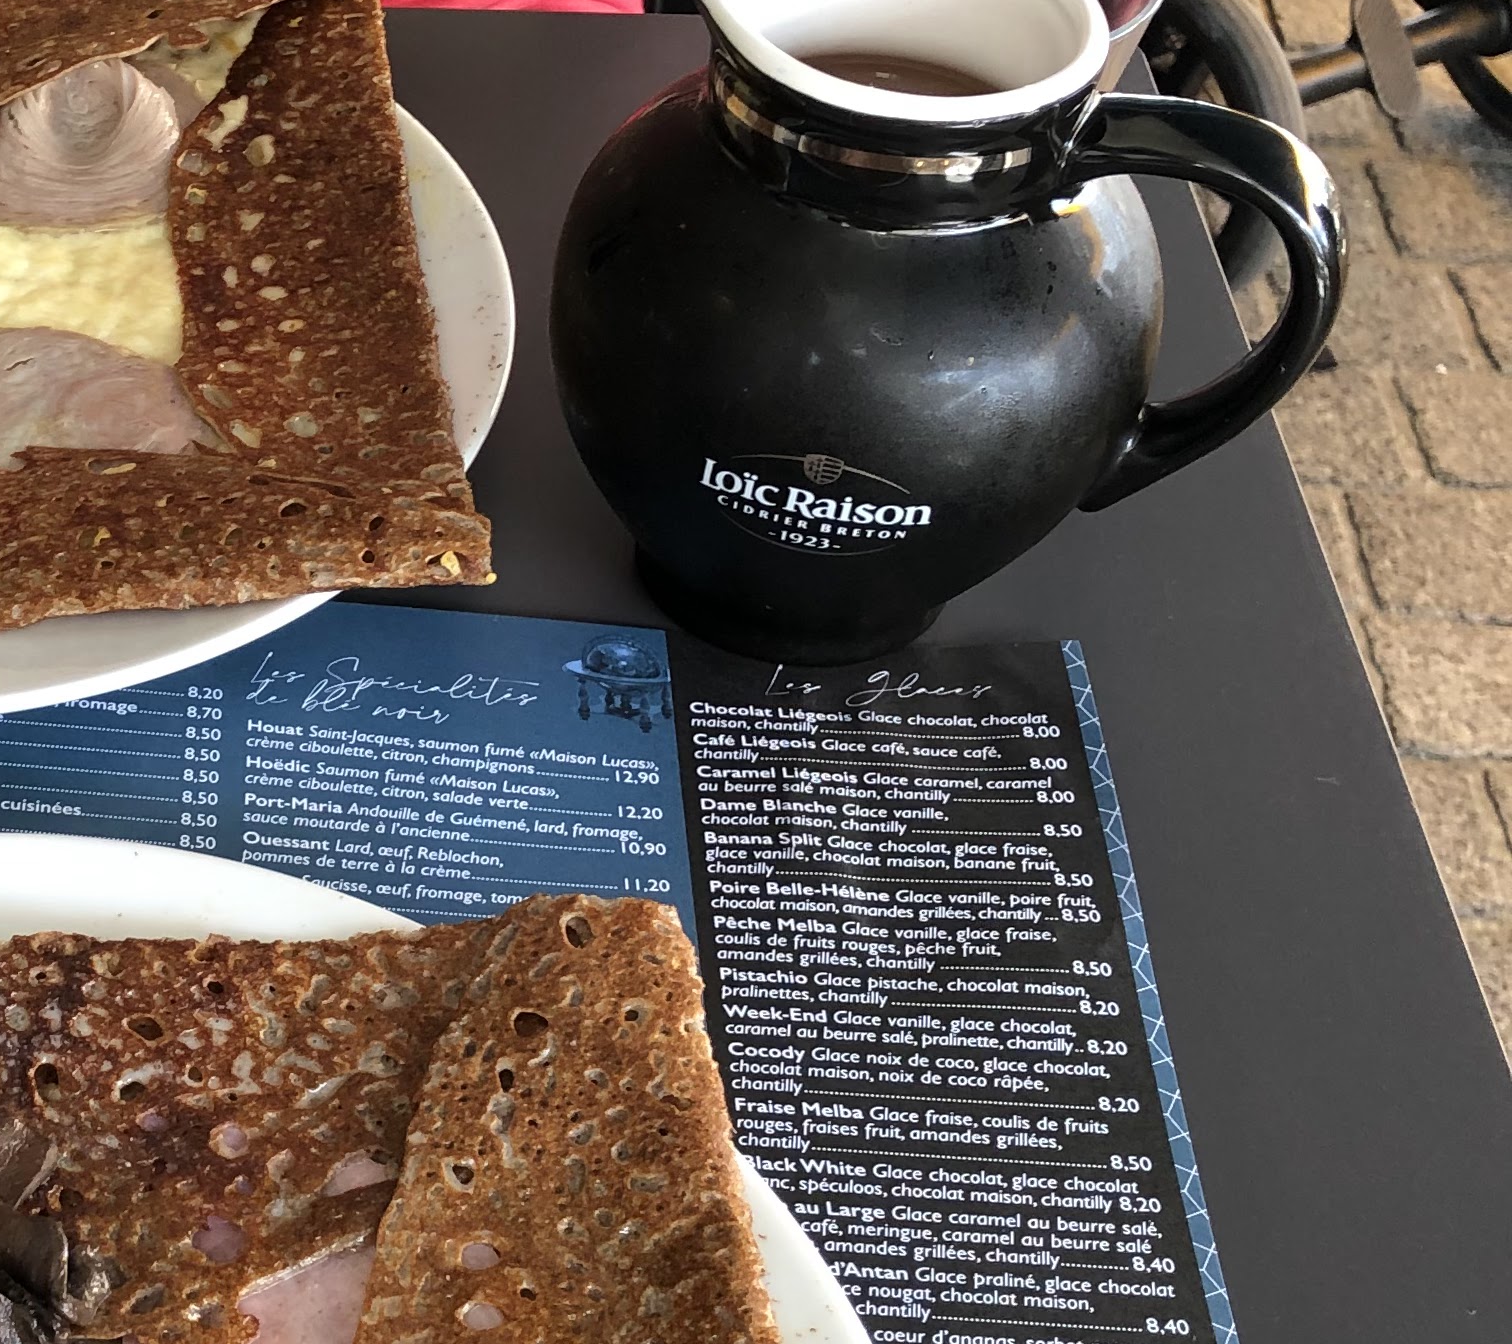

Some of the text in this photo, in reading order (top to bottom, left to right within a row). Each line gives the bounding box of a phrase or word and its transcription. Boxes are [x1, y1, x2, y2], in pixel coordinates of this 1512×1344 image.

[699, 457, 932, 527] Loïc Raison
[717, 494, 908, 541] CIDRIER BRETON
[249, 651, 306, 685] Les
[764, 664, 822, 697] Les
[371, 699, 450, 725] noir
[689, 701, 1048, 729] Chocolat Liégeois Glace chocolat, chocolat
[247, 719, 659, 772] Houat Saint-Jacques, saumon fumé «Maison Lucas»,
[692, 732, 1003, 761] Café Liégeois Glace café, sauce café,
[246, 755, 560, 800] Hoëdic Saumon fumé «Maison Lucas»,
[614, 769, 660, 787] 12,90
[1029, 757, 1068, 771] 8,00
[181, 790, 219, 807] 8,50
[617, 804, 663, 822] 12,20
[700, 797, 949, 822] Dame Blanche Glace vanille,
[244, 792, 643, 844] Port-Maria Andouille de Guémené, lard, fromage,
[1043, 824, 1083, 839] 8,50
[243, 830, 504, 868] Ouessant Lard, œuf, Reblochon,
[619, 840, 667, 858] 10,90
[704, 831, 1053, 860] Banana Split Glace chocolat, glace fraise,
[714, 914, 1057, 946] Pêche Melba Glace vanille, glace fraise,
[719, 966, 1090, 999] Pistachio Glace pistache, chocolat maison,
[734, 1097, 1109, 1137] Fraise Melba Glace fraise, coulis de fruits
[1109, 1154, 1152, 1173] 8,50
[794, 1200, 1163, 1239] au Large Glace caramel au beurre salé,
[1132, 1256, 1175, 1275] 8,40
